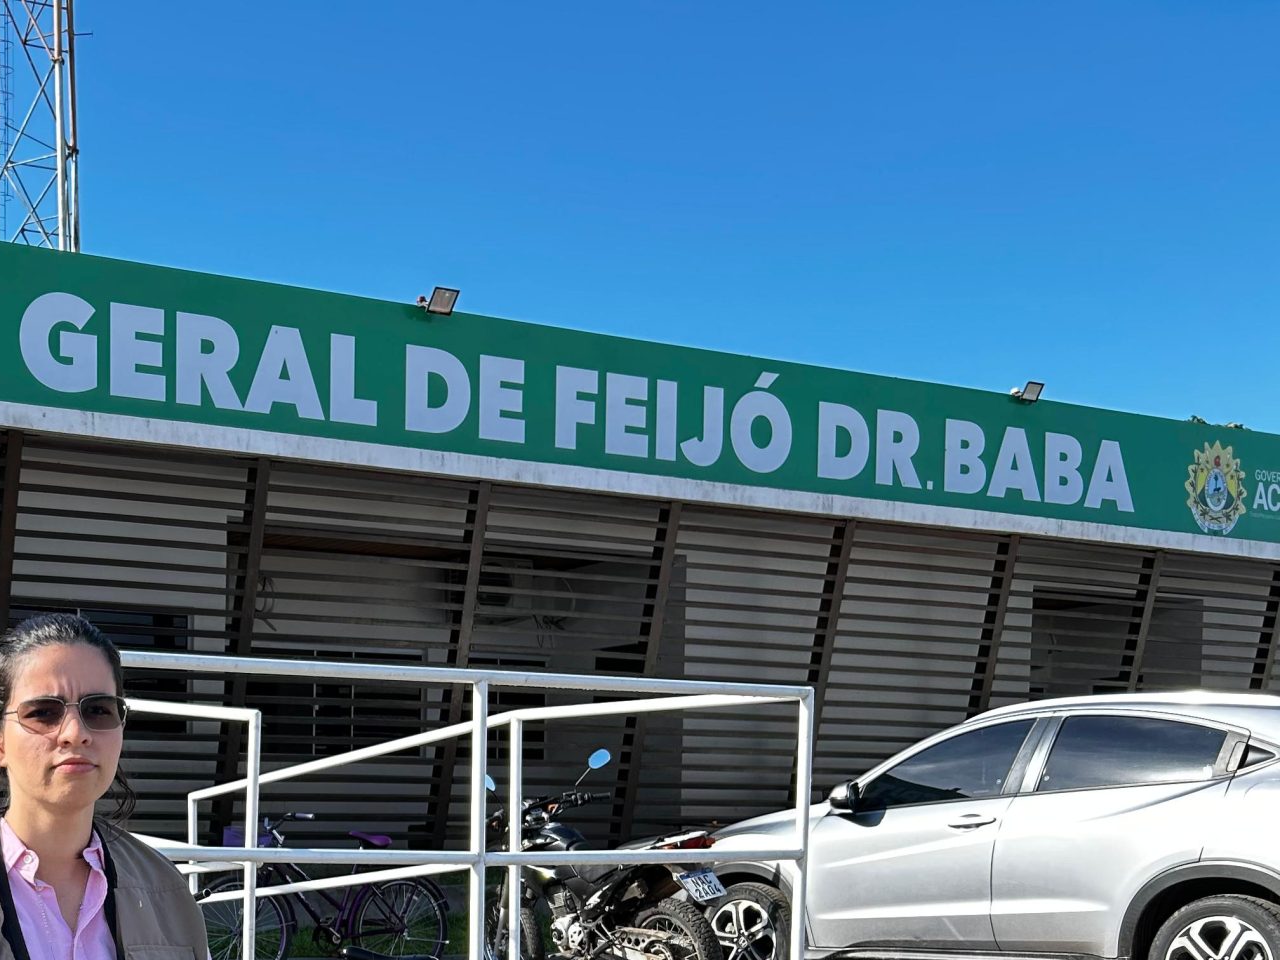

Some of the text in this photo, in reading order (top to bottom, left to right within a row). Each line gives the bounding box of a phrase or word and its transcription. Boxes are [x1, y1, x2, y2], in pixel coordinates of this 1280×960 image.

[19, 292, 378, 427] GERAL
[405, 344, 526, 444] DE
[555, 372, 793, 473] FEIJÓ
[817, 401, 934, 490] DR.
[944, 418, 1135, 513] BABA
[690, 874, 712, 889] NAC
[694, 884, 722, 898] 2A04
